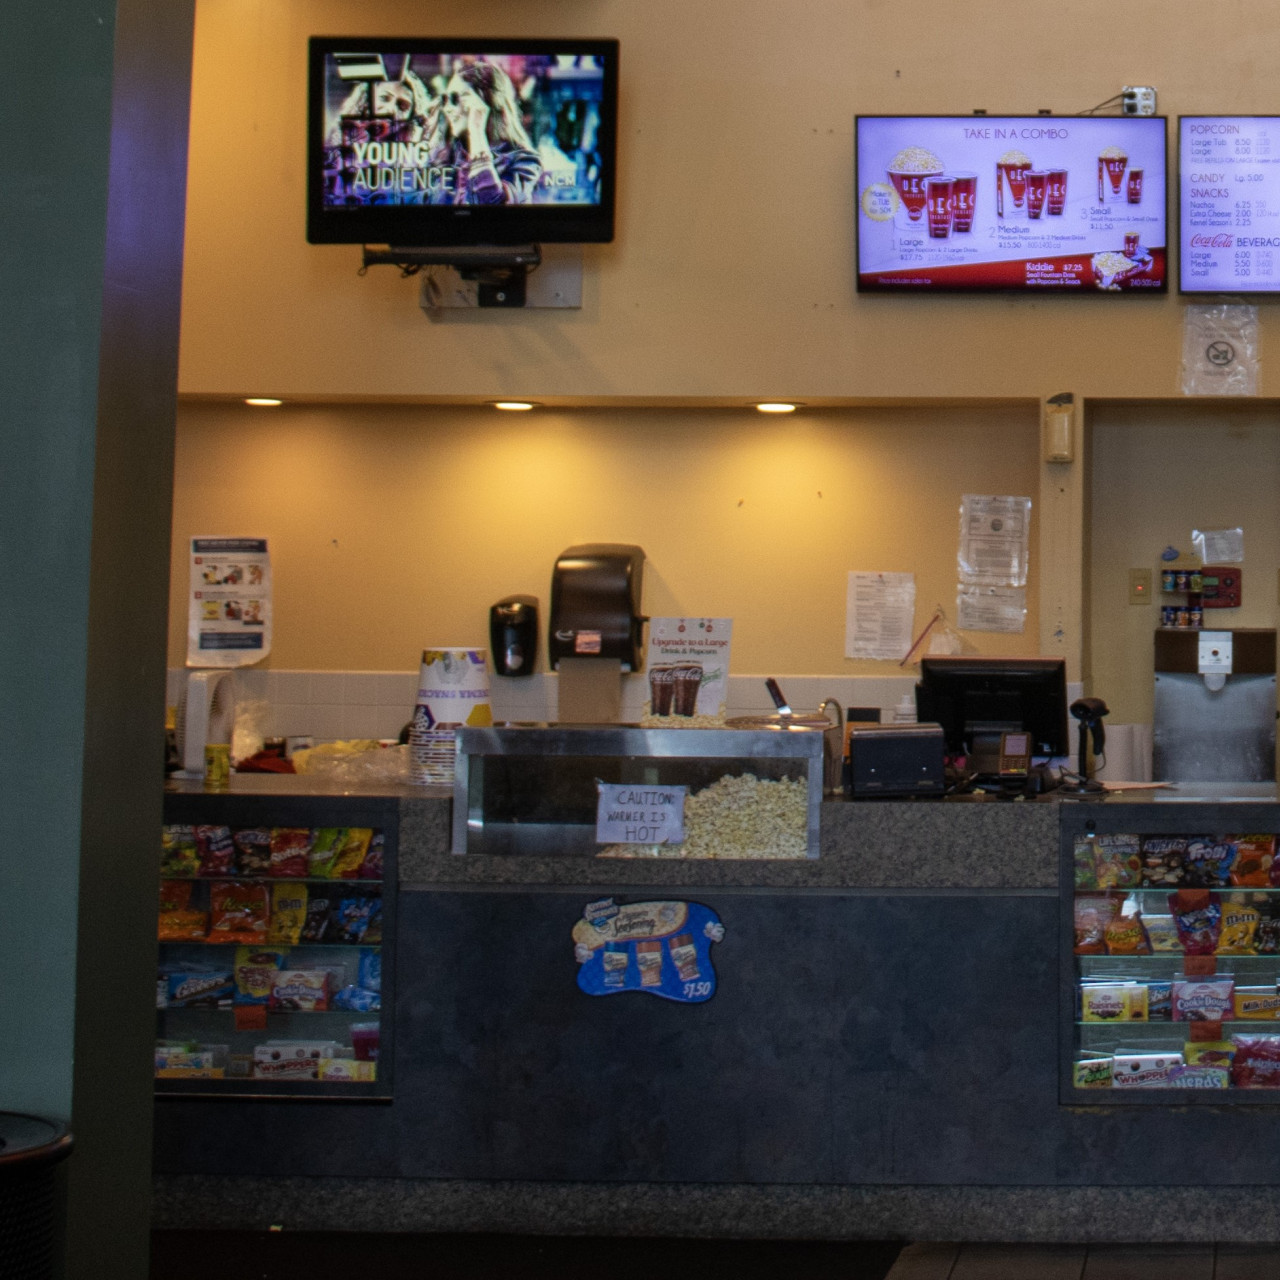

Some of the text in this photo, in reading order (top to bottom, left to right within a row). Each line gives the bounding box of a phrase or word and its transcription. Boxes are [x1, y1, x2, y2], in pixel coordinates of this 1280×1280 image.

[964, 128, 1069, 139] TAKE IN A COMBO
[1190, 125, 1239, 134] POPCORN
[1191, 139, 1211, 147] Large
[353, 141, 430, 166] YOUNG
[1191, 147, 1211, 156] Large
[353, 168, 454, 190] AUDIENCE
[544, 175, 575, 187] NCM
[1190, 173, 1225, 183] CANDY
[1190, 188, 1229, 198] SNACKS
[1090, 207, 1111, 215] Small
[900, 238, 924, 248] Large
[1190, 252, 1211, 260] Large
[1026, 262, 1054, 271] Kiddie
[1190, 260, 1218, 268] Medium
[705, 638, 728, 648] Large
[607, 811, 666, 822] WARMER IS
[625, 826, 660, 841] HOT
[683, 982, 711, 998] $1.50
[1242, 1000, 1260, 1011] Milk
